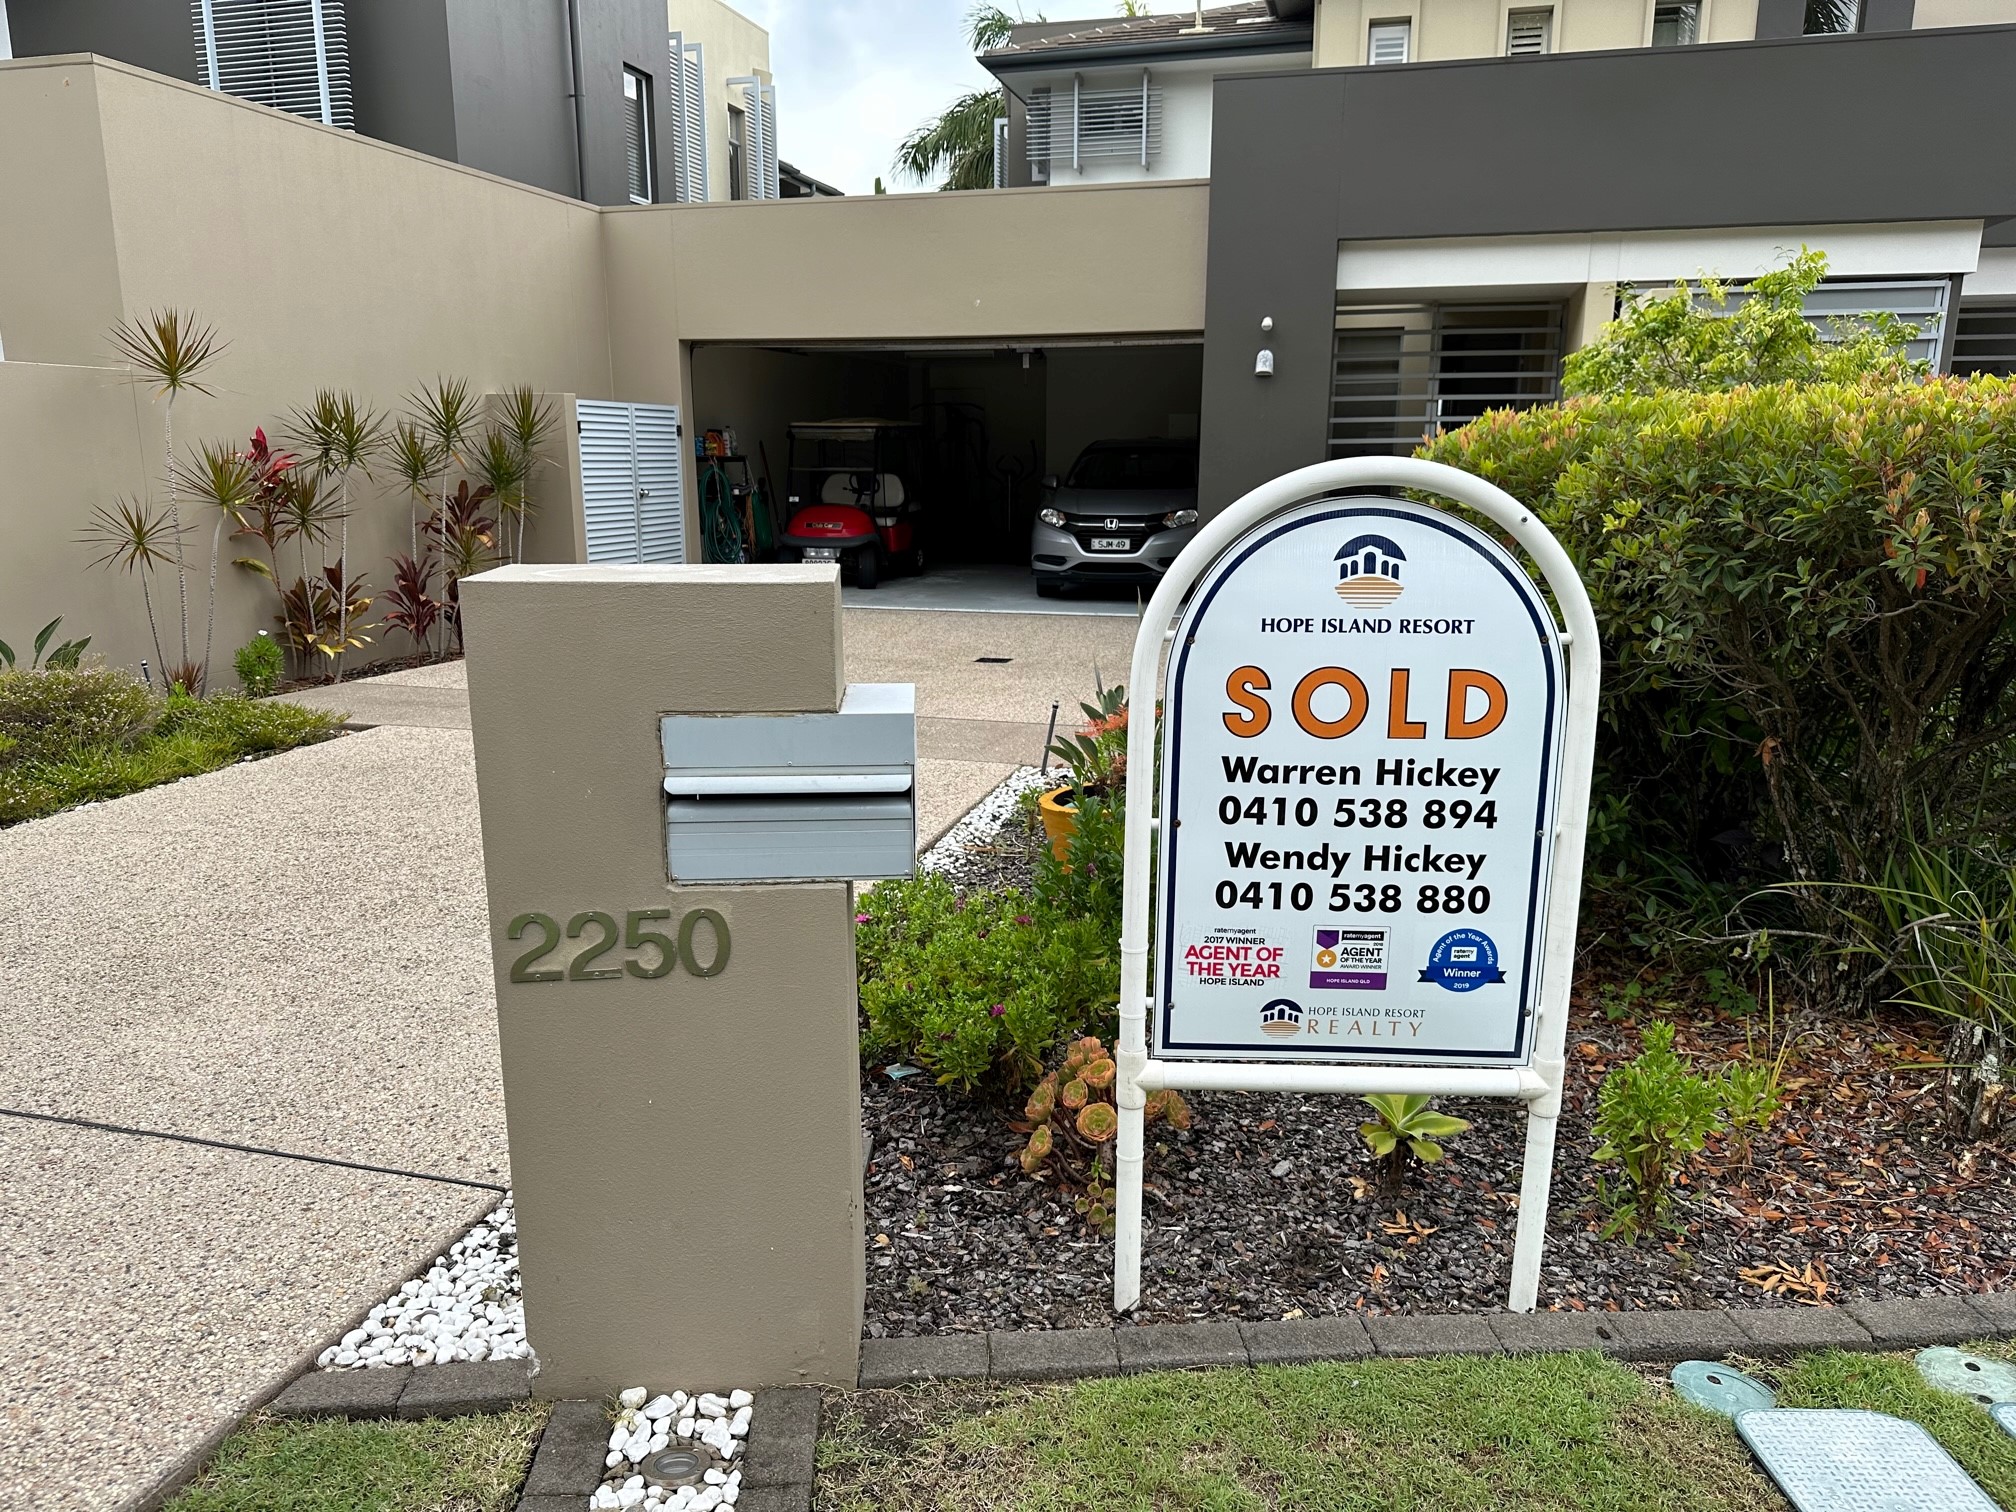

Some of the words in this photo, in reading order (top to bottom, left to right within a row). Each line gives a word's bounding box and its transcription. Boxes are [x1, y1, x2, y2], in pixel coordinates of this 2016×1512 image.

[1261, 617, 1314, 632] HOPE
[1321, 618, 1392, 633] ISLAND
[1399, 619, 1475, 634] RESORT
[1222, 665, 1508, 740] SOLD
[1221, 756, 1361, 785] Warren
[1375, 758, 1501, 794] Hickey
[1218, 796, 1318, 826] 0410
[1333, 798, 1408, 828] 538
[1422, 800, 1498, 829] 894
[1224, 841, 1351, 878] Wendy
[1363, 845, 1487, 880] Hickey
[1215, 880, 1314, 910] 0410
[1328, 884, 1402, 912] 538
[1416, 885, 1491, 914] 880
[507, 908, 731, 983] 2250
[1204, 936, 1224, 944] 2017
[1226, 937, 1265, 945] WINNER
[1433, 942, 1447, 962] Agent
[1445, 936, 1453, 944] of
[1467, 932, 1482, 942] Year
[1481, 941, 1495, 965] Awards
[1184, 945, 1252, 960] AGENT
[1256, 947, 1284, 961] OF
[1341, 947, 1383, 957] AGENT
[1187, 962, 1224, 976] THE
[1228, 963, 1280, 978] YEAR
[1443, 968, 1481, 977] Winner
[1199, 977, 1227, 985] HOPE
[1229, 978, 1264, 986] ISLAND
[1308, 1006, 1338, 1016] HOPE
[1341, 1007, 1381, 1017] ISLAND
[1384, 1008, 1426, 1018] RESORT
[1307, 1019, 1423, 1037] REALTY
